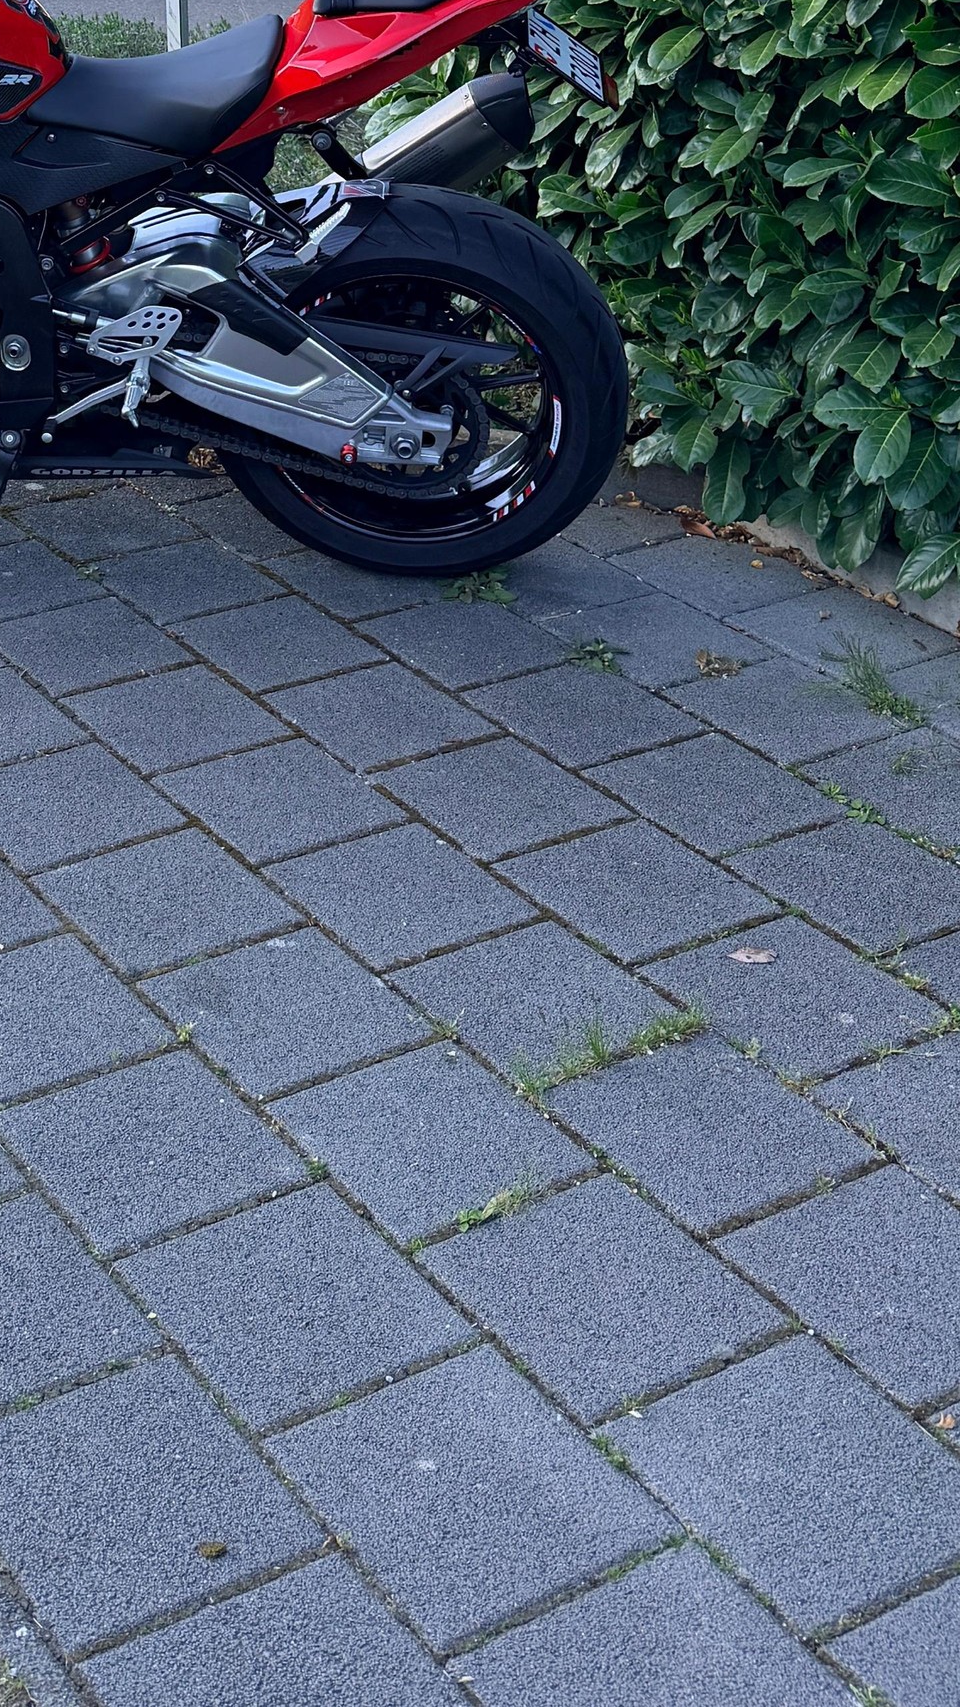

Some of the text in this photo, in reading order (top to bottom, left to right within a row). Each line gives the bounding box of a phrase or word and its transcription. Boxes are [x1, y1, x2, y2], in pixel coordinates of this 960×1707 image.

[529, 18, 561, 56] ZH
[0, 74, 34, 86] RR
[568, 37, 603, 99] 73001
[30, 468, 177, 476] GODZILLA
